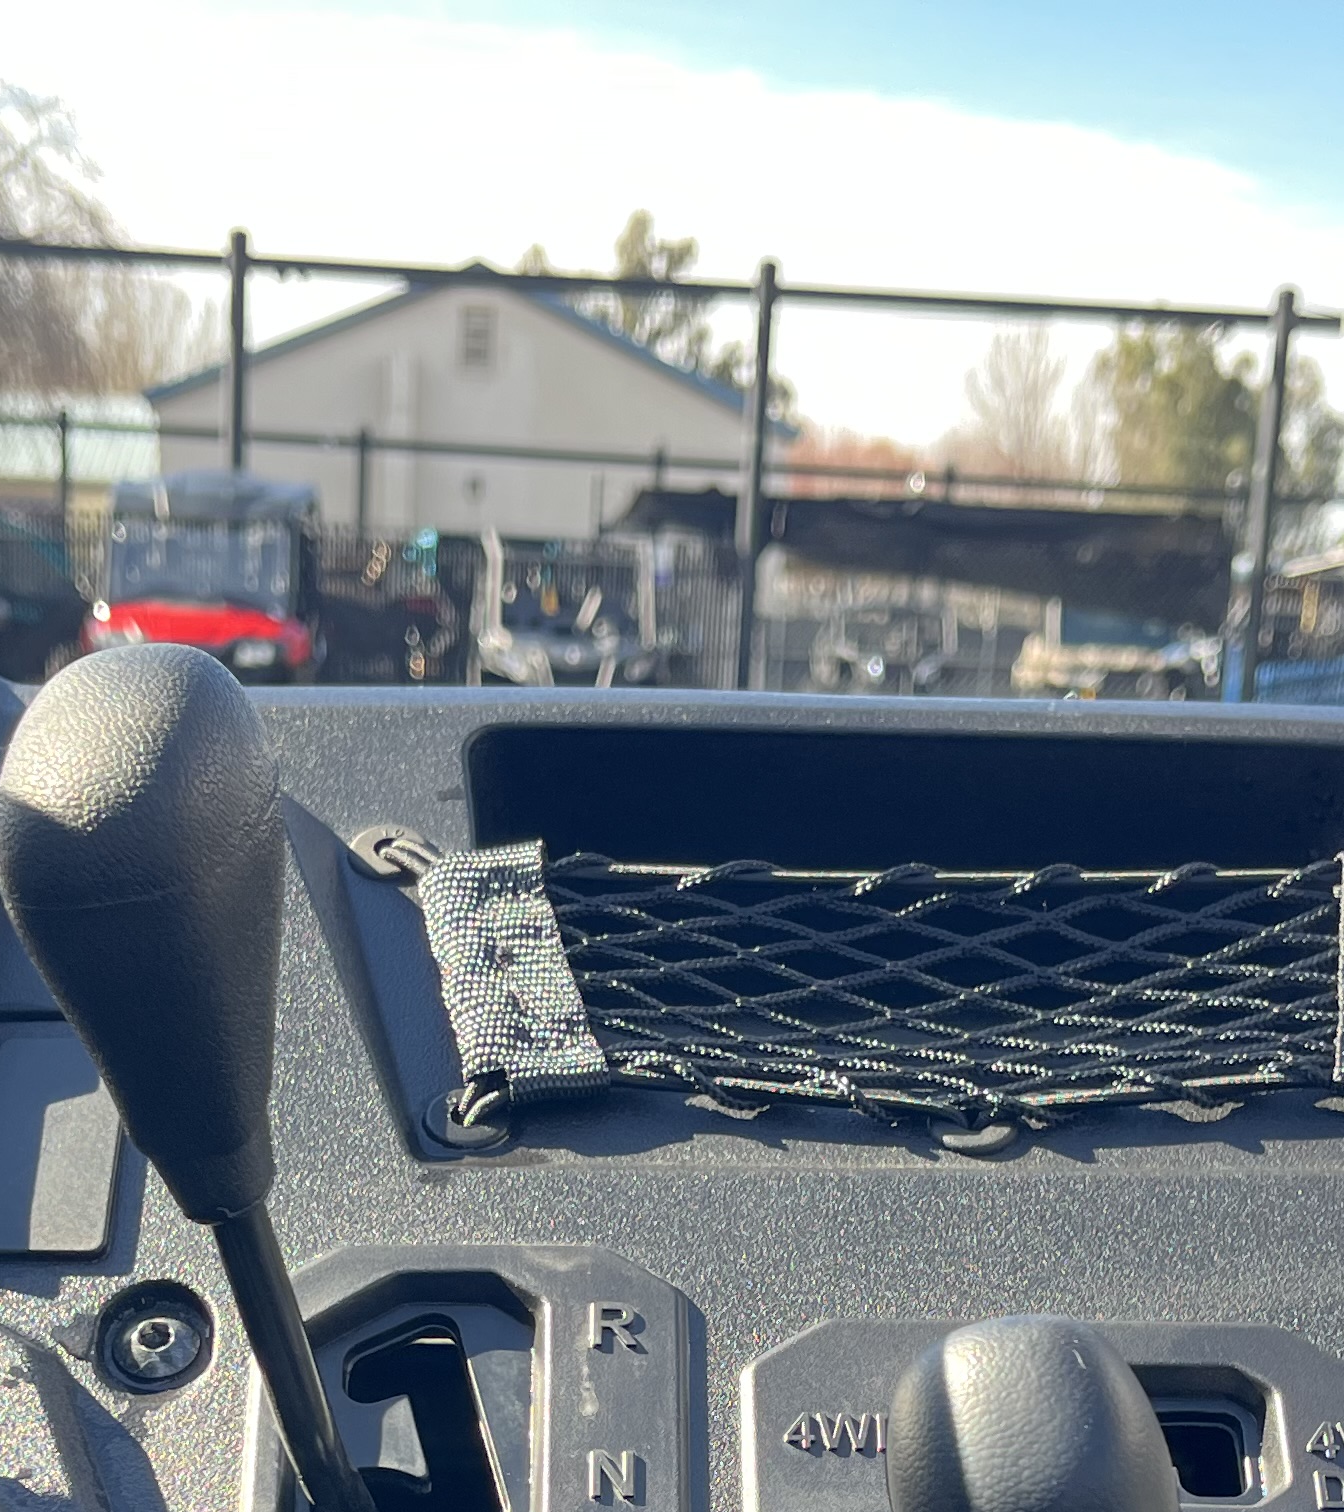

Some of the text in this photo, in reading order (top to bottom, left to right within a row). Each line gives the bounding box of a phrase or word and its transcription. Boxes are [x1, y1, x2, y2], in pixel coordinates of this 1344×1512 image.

[589, 1302, 639, 1349] R
[783, 1412, 887, 1453] 4W
[589, 1449, 636, 1500] N
